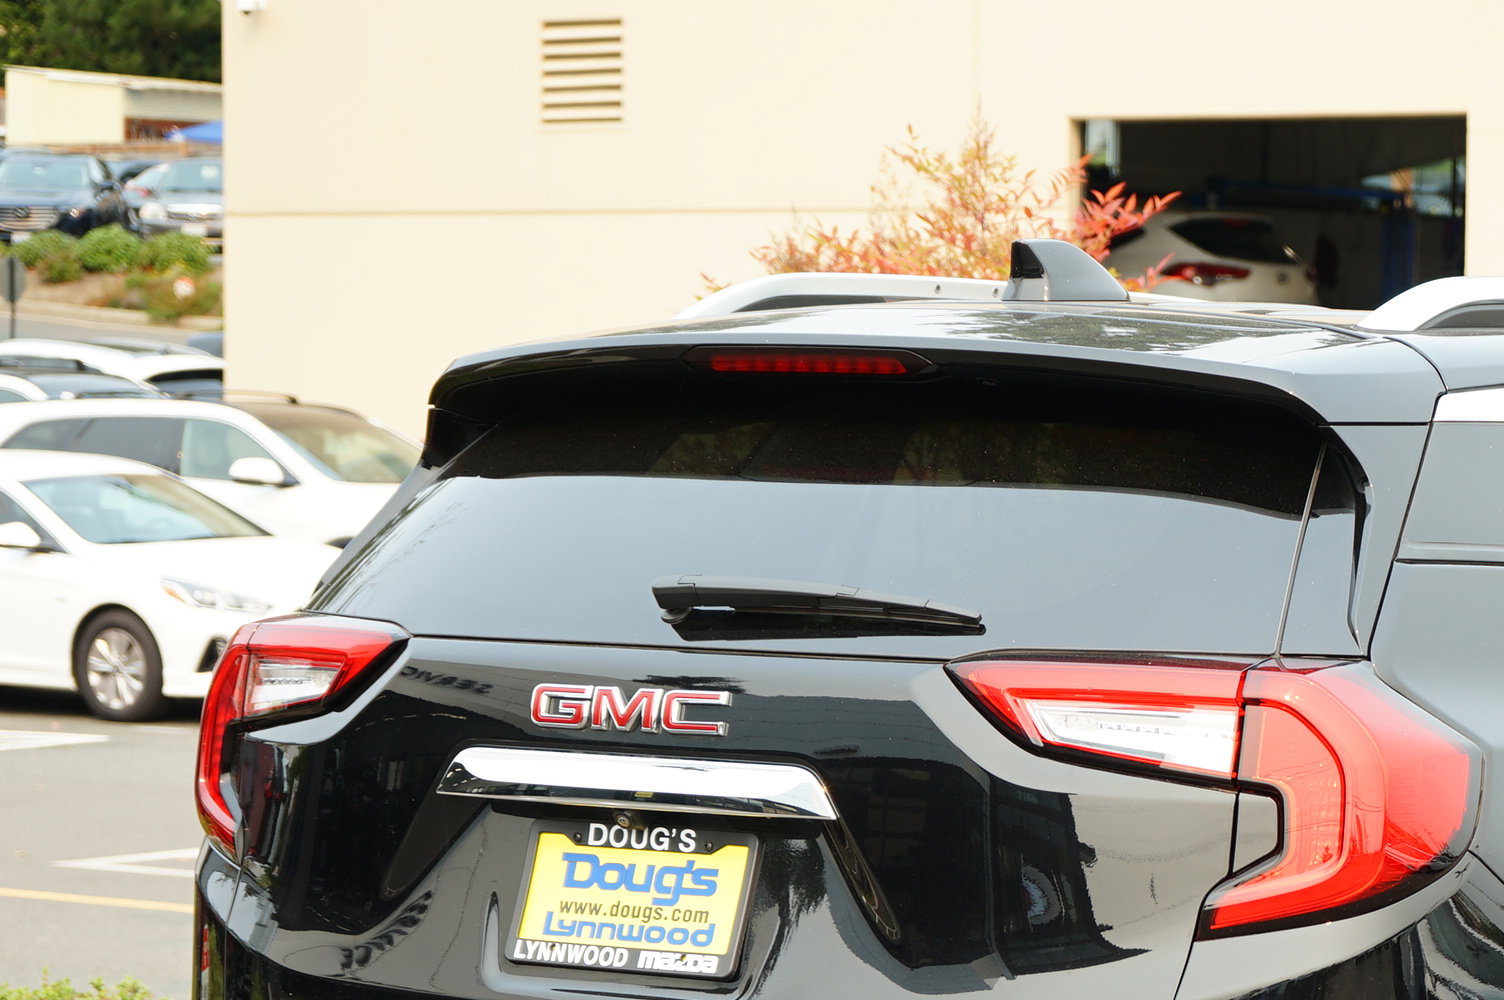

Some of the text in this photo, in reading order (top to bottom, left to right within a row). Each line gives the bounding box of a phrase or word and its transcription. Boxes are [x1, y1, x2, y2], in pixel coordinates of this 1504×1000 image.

[531, 683, 733, 736] GMC
[587, 823, 697, 853] DOUG'S
[562, 852, 719, 906] Doug's
[560, 900, 709, 923] www.dougs.com
[543, 911, 716, 947] Lynnwood
[513, 939, 628, 968] LYNNWOOD
